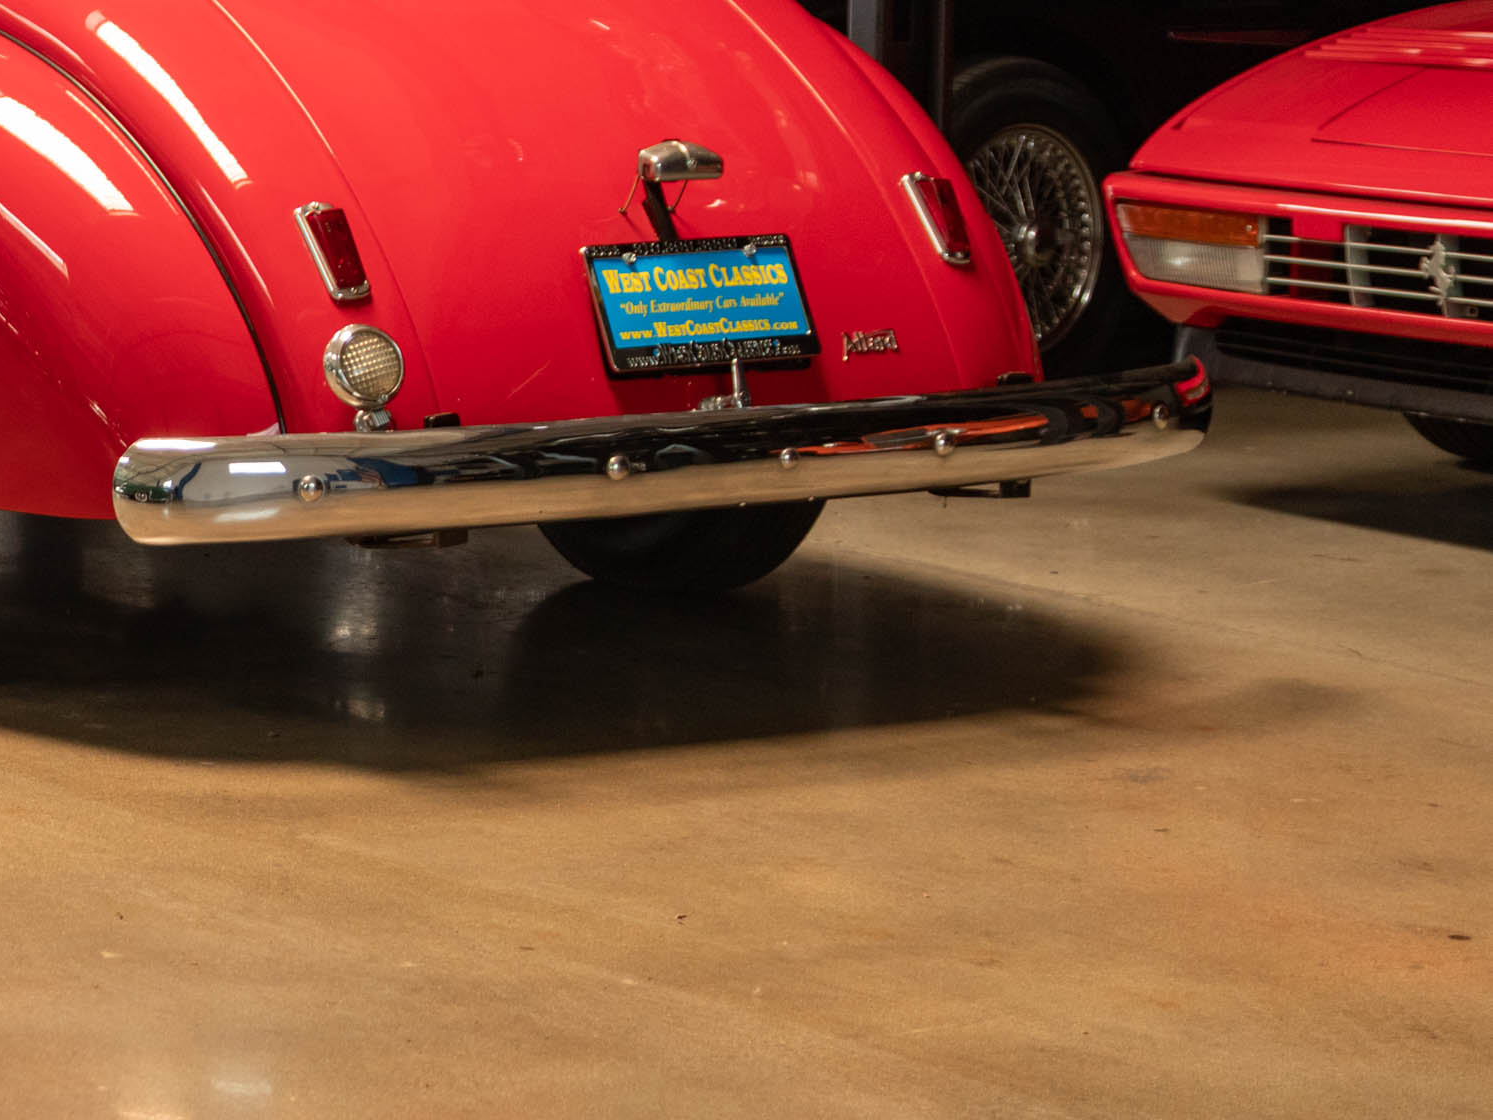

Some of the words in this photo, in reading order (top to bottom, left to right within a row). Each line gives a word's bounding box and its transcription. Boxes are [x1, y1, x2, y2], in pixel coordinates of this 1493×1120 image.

[602, 269, 652, 294] WEST
[653, 266, 707, 291] COAST
[709, 263, 788, 288] CLASSICS
[650, 297, 714, 313] Extraordinary
[715, 295, 737, 309] Cars
